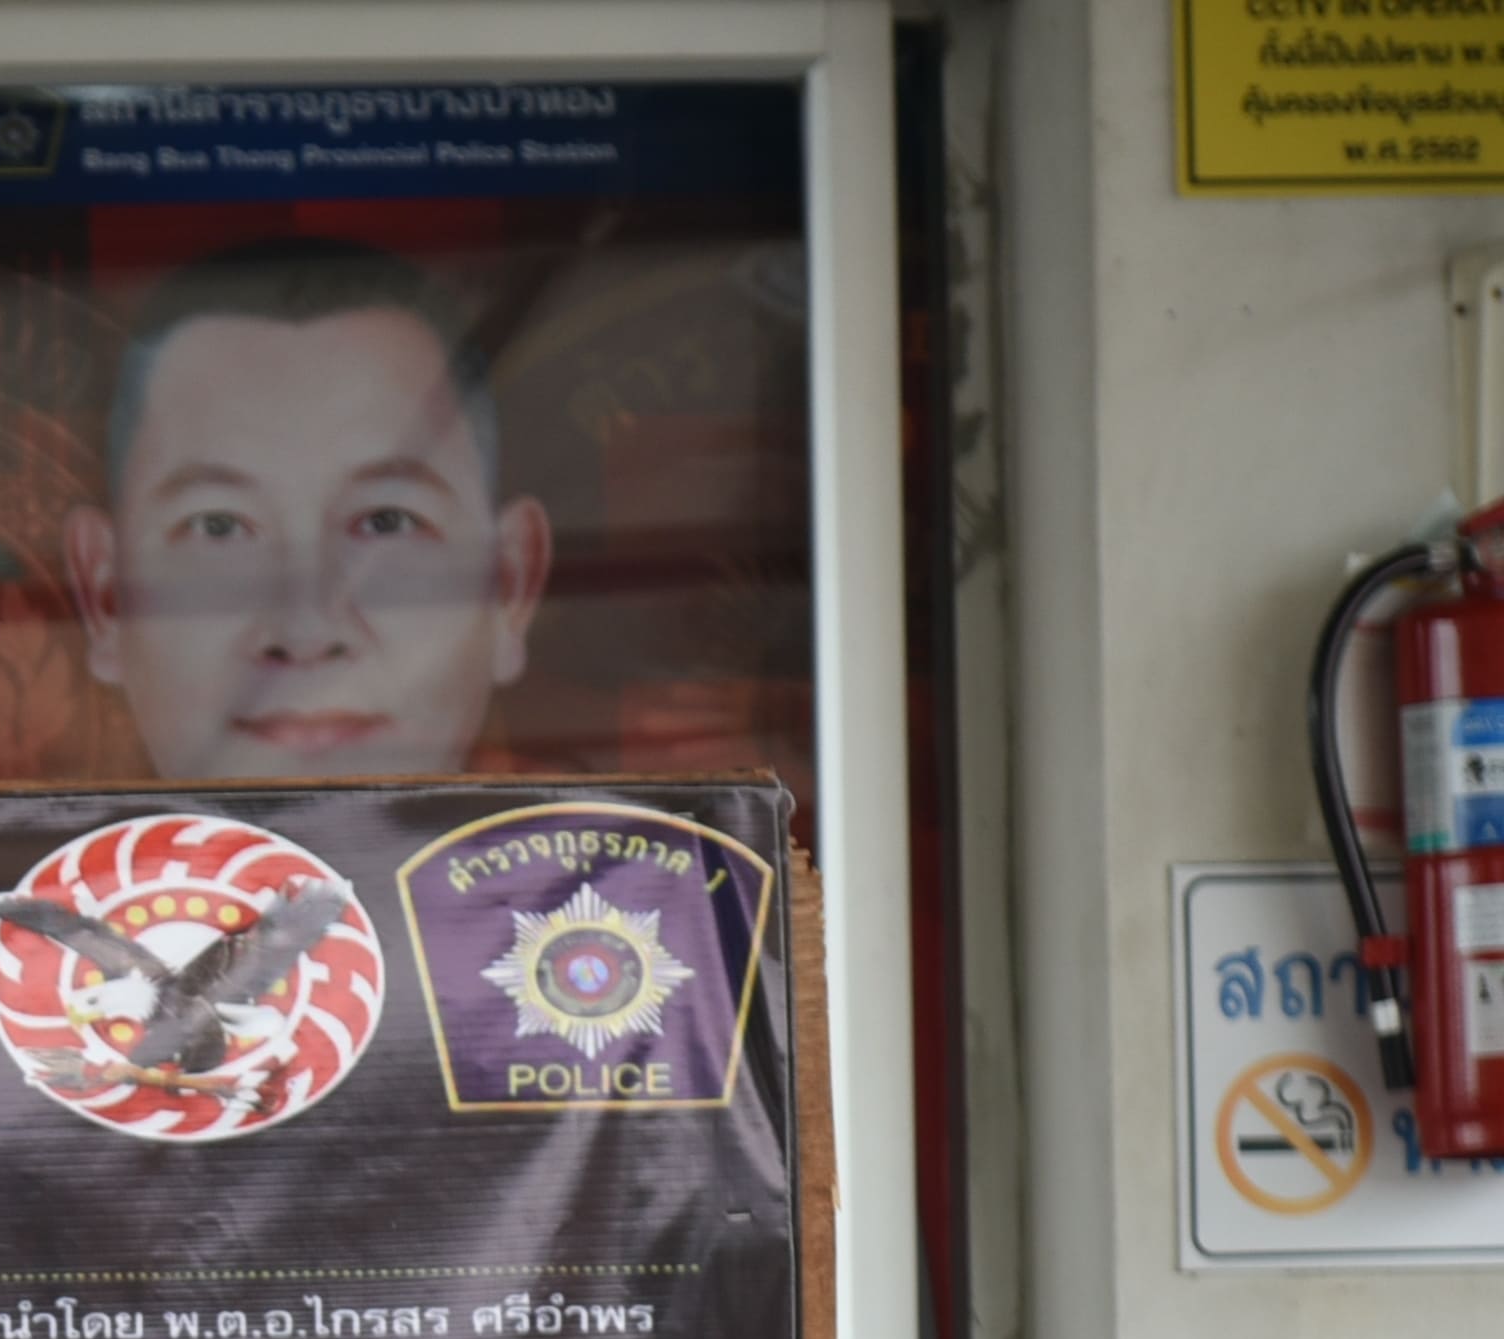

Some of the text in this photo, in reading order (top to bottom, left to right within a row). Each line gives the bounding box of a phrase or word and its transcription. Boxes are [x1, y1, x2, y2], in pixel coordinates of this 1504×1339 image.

[435, 140, 513, 166] Police
[519, 138, 619, 164] Station
[445, 828, 695, 894] ตำรวจภูธรภาค
[507, 1062, 673, 1099] POLICE
[471, 1292, 655, 1338] ศรีอำพร
